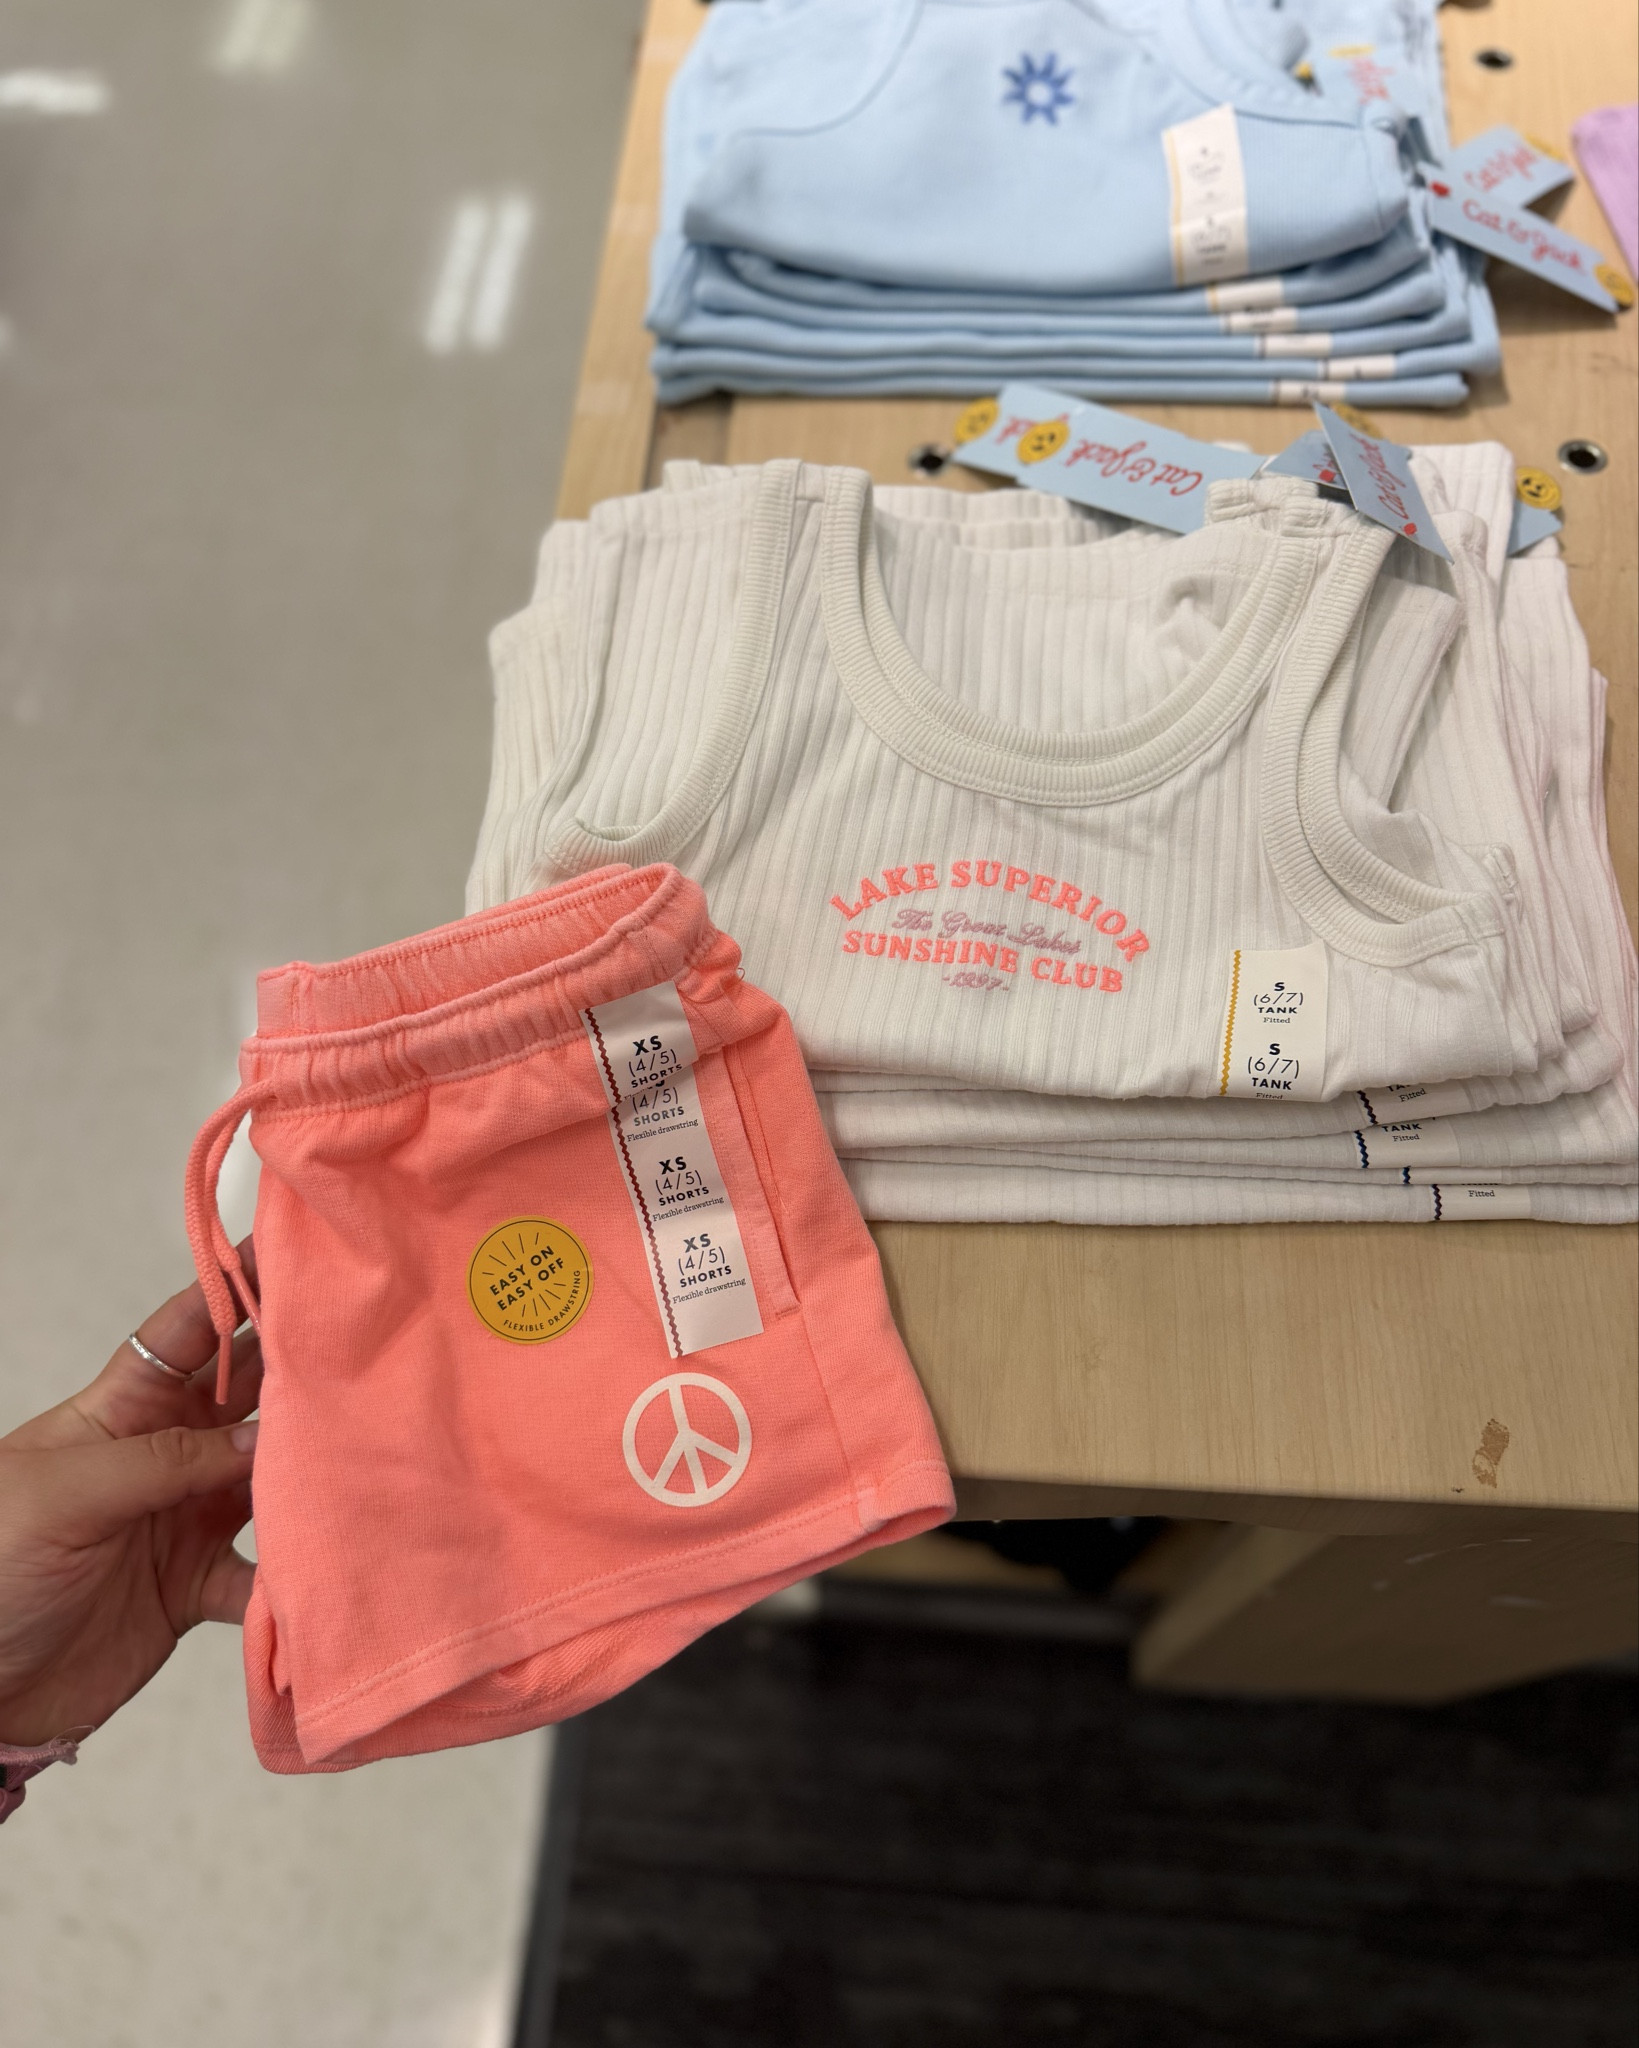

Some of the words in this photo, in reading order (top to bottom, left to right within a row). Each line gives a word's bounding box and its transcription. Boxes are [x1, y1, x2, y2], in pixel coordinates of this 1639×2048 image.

[1064, 438, 1147, 478] Jack
[1121, 457, 1157, 483] &
[1149, 463, 1203, 496] Cat
[829, 863, 939, 921] LAKE
[950, 860, 1151, 963] SUPERIOR
[842, 930, 1020, 973] SUNSHINE
[1030, 956, 1123, 993] CLUB
[1273, 981, 1286, 992] S
[1253, 992, 1304, 1007] (6/7)
[1257, 1006, 1298, 1014] TANK
[1263, 1016, 1291, 1024] Fitted
[632, 1035, 663, 1057] XS
[1268, 1043, 1281, 1056] S
[628, 1048, 677, 1078] (4/5)
[1247, 1056, 1300, 1080] (6/7)
[631, 1063, 683, 1089] SHORTS
[1251, 1077, 1293, 1091] TANK
[632, 1086, 679, 1115] (4/5)
[1398, 1088, 1427, 1102] Fitted
[633, 1106, 685, 1127] SHORTS
[1381, 1123, 1422, 1133] TANK
[626, 1129, 658, 1143] Flexible
[657, 1118, 699, 1135] drawstring
[1392, 1134, 1420, 1142] Fitted
[658, 1156, 687, 1175] XS
[655, 1169, 702, 1196] (4/5)
[1468, 1189, 1496, 1198] Fitted
[658, 1186, 710, 1207] SHORTS
[652, 1206, 684, 1222] Flexible
[683, 1196, 725, 1213] drawstring
[683, 1233, 712, 1253] XS
[489, 1264, 527, 1297] EASY
[530, 1245, 555, 1268] ON
[678, 1246, 726, 1276] (4/5)
[497, 1279, 534, 1312] EASY
[537, 1257, 564, 1281] OFF
[679, 1265, 733, 1288] SHORTS
[503, 1319, 545, 1332] FLEXIBLE
[547, 1269, 581, 1326] DRAWSTRING
[672, 1287, 705, 1305] Flexible
[703, 1277, 747, 1295] drawstring
